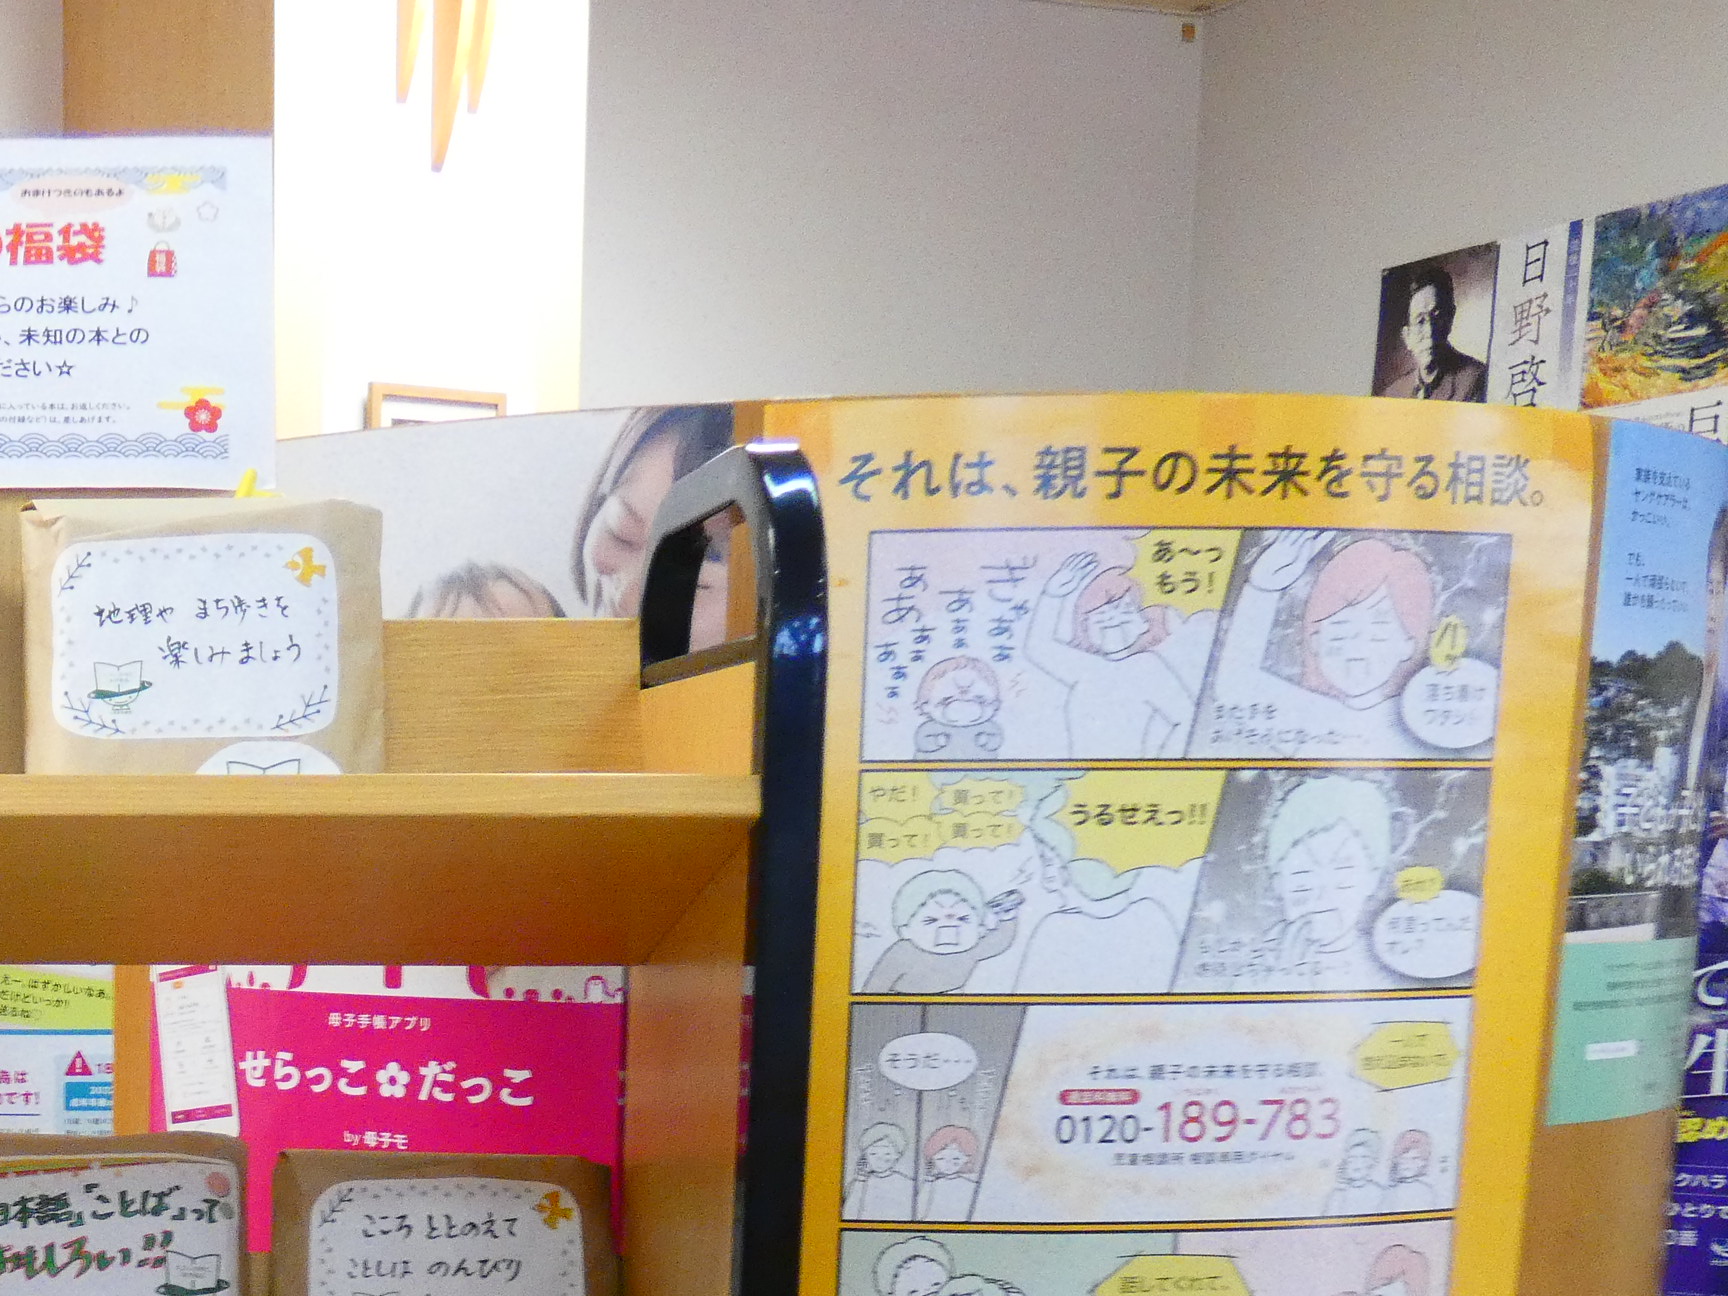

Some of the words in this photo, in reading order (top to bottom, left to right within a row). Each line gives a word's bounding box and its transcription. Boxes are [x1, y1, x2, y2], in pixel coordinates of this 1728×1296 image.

[838, 444, 1545, 509] それは、親子の未来を守る相談。
[93, 601, 174, 628] 地理や
[194, 594, 291, 626] まち歩きを
[158, 633, 303, 669] 楽しみましょう
[328, 1012, 432, 1032] 母子手帳アプリ
[1054, 1097, 1342, 1144] 0120-189-783
[363, 1131, 409, 1150] 母子モ
[361, 1214, 414, 1240] こころ
